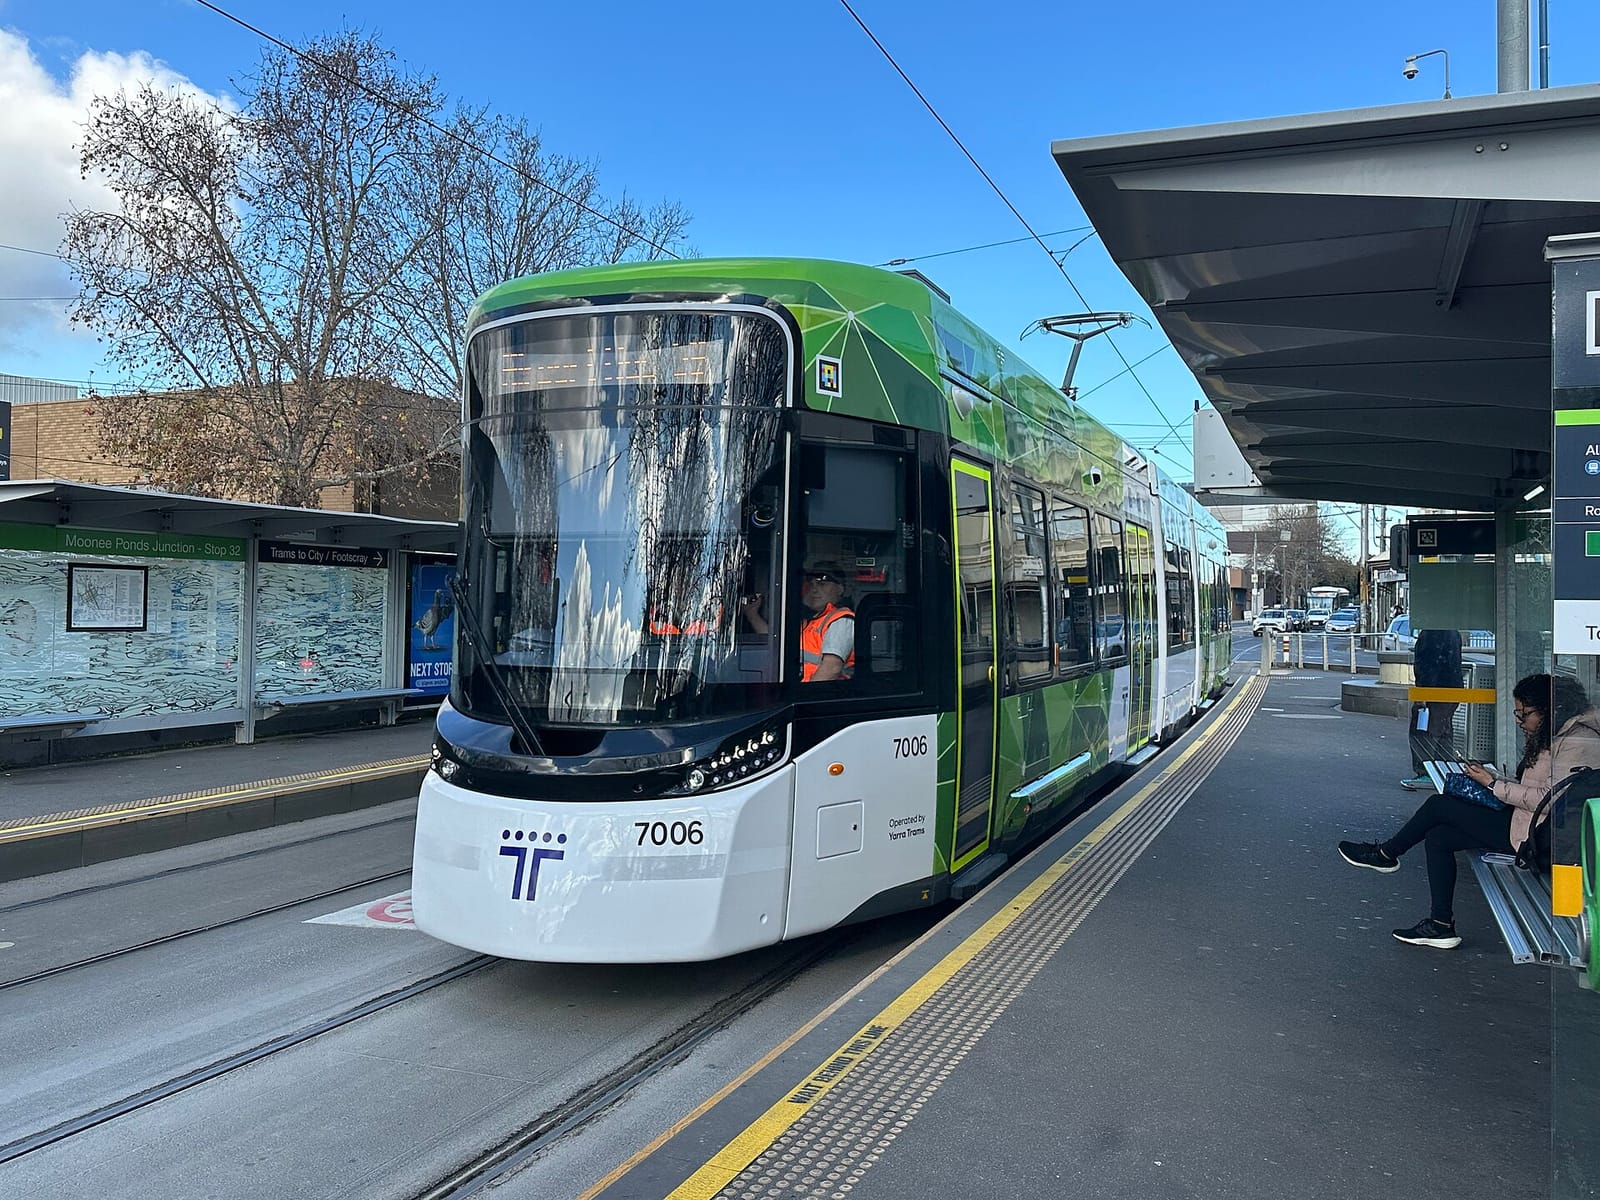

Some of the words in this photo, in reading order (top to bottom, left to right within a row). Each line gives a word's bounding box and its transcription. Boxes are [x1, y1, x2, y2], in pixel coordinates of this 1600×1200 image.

[65, 534, 112, 549] Moonee
[115, 537, 150, 551] Ponds
[152, 540, 195, 553] Junction
[204, 543, 227, 557] Stop
[229, 545, 241, 556] 32
[270, 547, 296, 559] Trams
[298, 549, 306, 560] to
[308, 549, 324, 563] City
[332, 551, 368, 565] Footscray
[410, 662, 433, 677] NEXT
[893, 735, 928, 759] 7006
[889, 814, 918, 828] Operated
[918, 813, 925, 824] by
[634, 820, 704, 846] 7006
[889, 830, 907, 841] Yarra
[907, 827, 925, 838] Trams
[787, 1082, 824, 1104] WAIT
[812, 1056, 855, 1083] BEHIND
[842, 1039, 873, 1055] THIS
[861, 1025, 889, 1040] LINE
